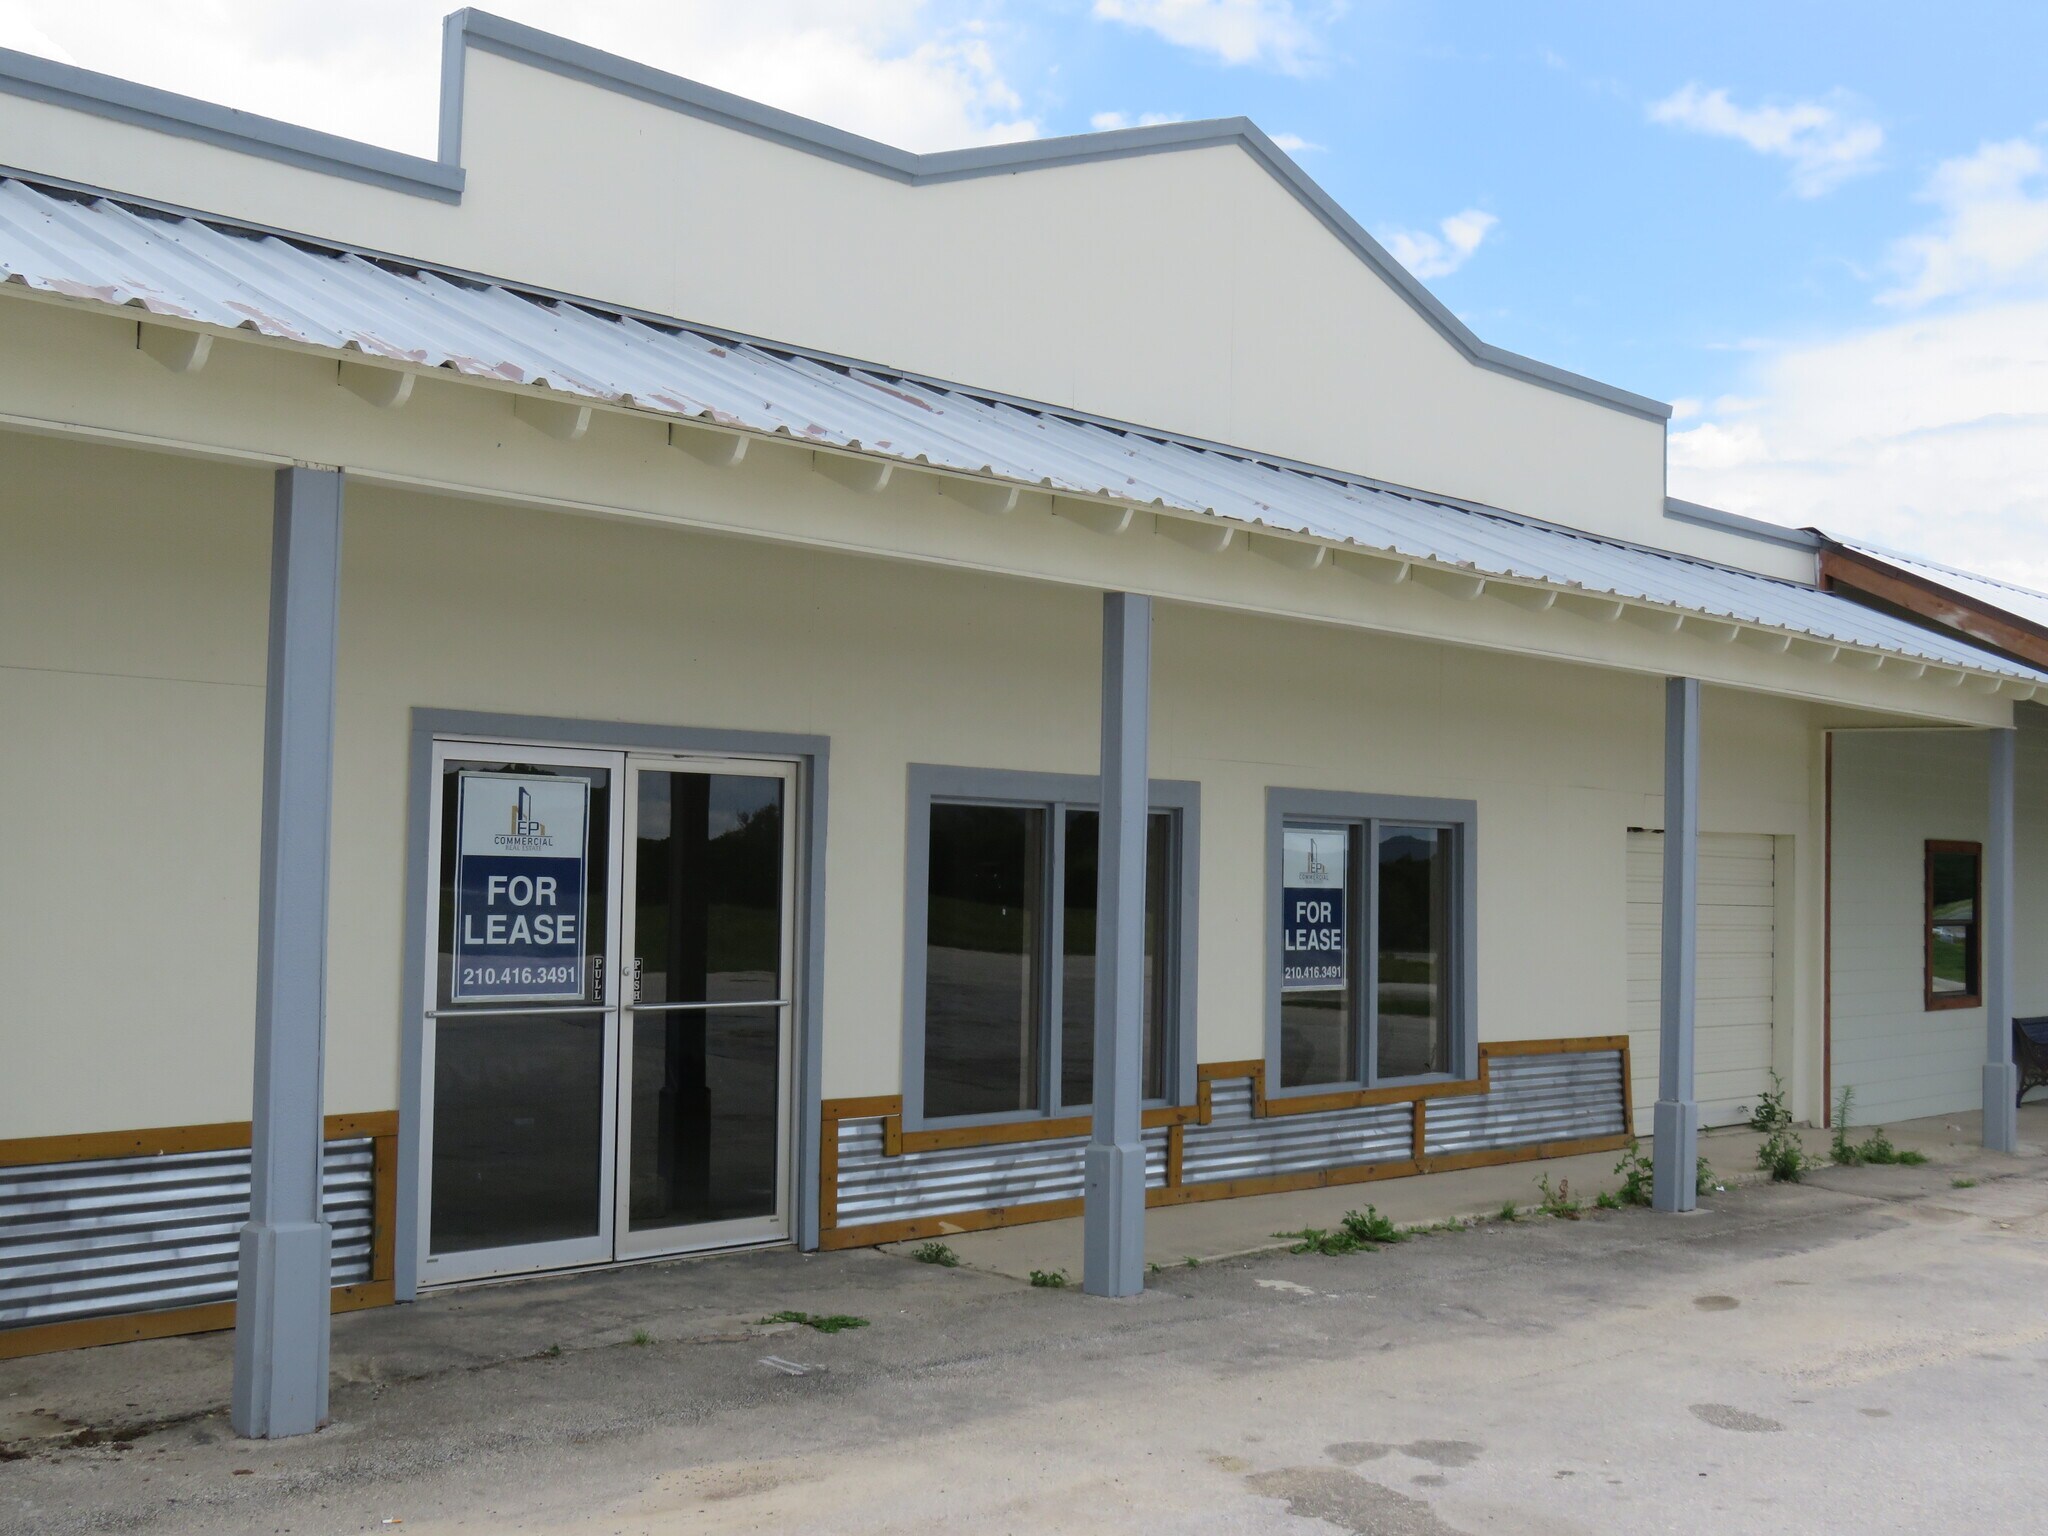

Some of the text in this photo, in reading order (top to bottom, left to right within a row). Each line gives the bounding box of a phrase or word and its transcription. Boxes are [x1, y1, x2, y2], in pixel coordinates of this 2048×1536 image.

[494, 836, 553, 847] COMMERCIAL
[487, 875, 557, 906] FOR
[1296, 901, 1332, 923] FOR
[464, 914, 576, 945] LEASE
[1285, 928, 1341, 951] LEASE
[463, 966, 576, 985] 210.416.3491
[594, 958, 602, 1000] PULL
[633, 960, 641, 1000] PUSH
[1285, 966, 1341, 979] 210.416.3491
